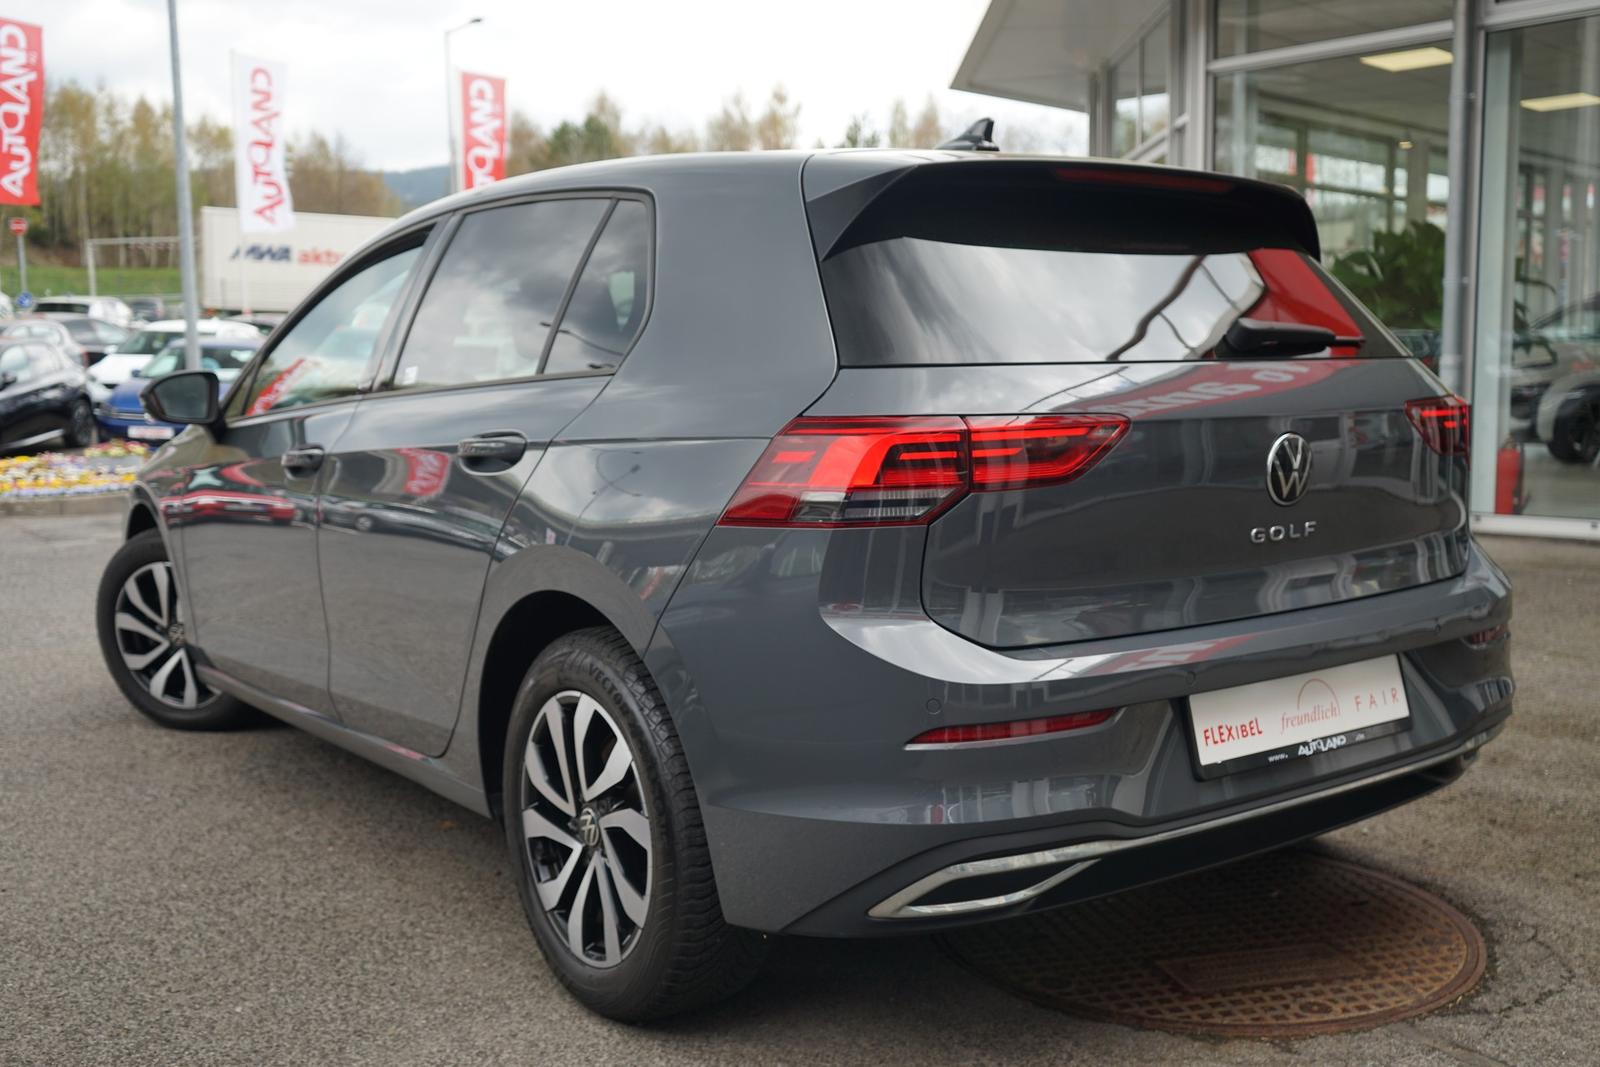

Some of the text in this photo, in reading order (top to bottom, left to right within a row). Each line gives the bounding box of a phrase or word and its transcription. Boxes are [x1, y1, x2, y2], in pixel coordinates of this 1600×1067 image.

[0, 24, 37, 198] AUTOLAND
[247, 68, 284, 225] AUTOLAND
[467, 79, 501, 190] TOLAND
[1267, 433, 1312, 505] VW
[1250, 521, 1316, 543] GOLF
[1203, 687, 1398, 747] FLEXIBEL freundlich FAIR
[1298, 734, 1346, 756] AUTOLAND
